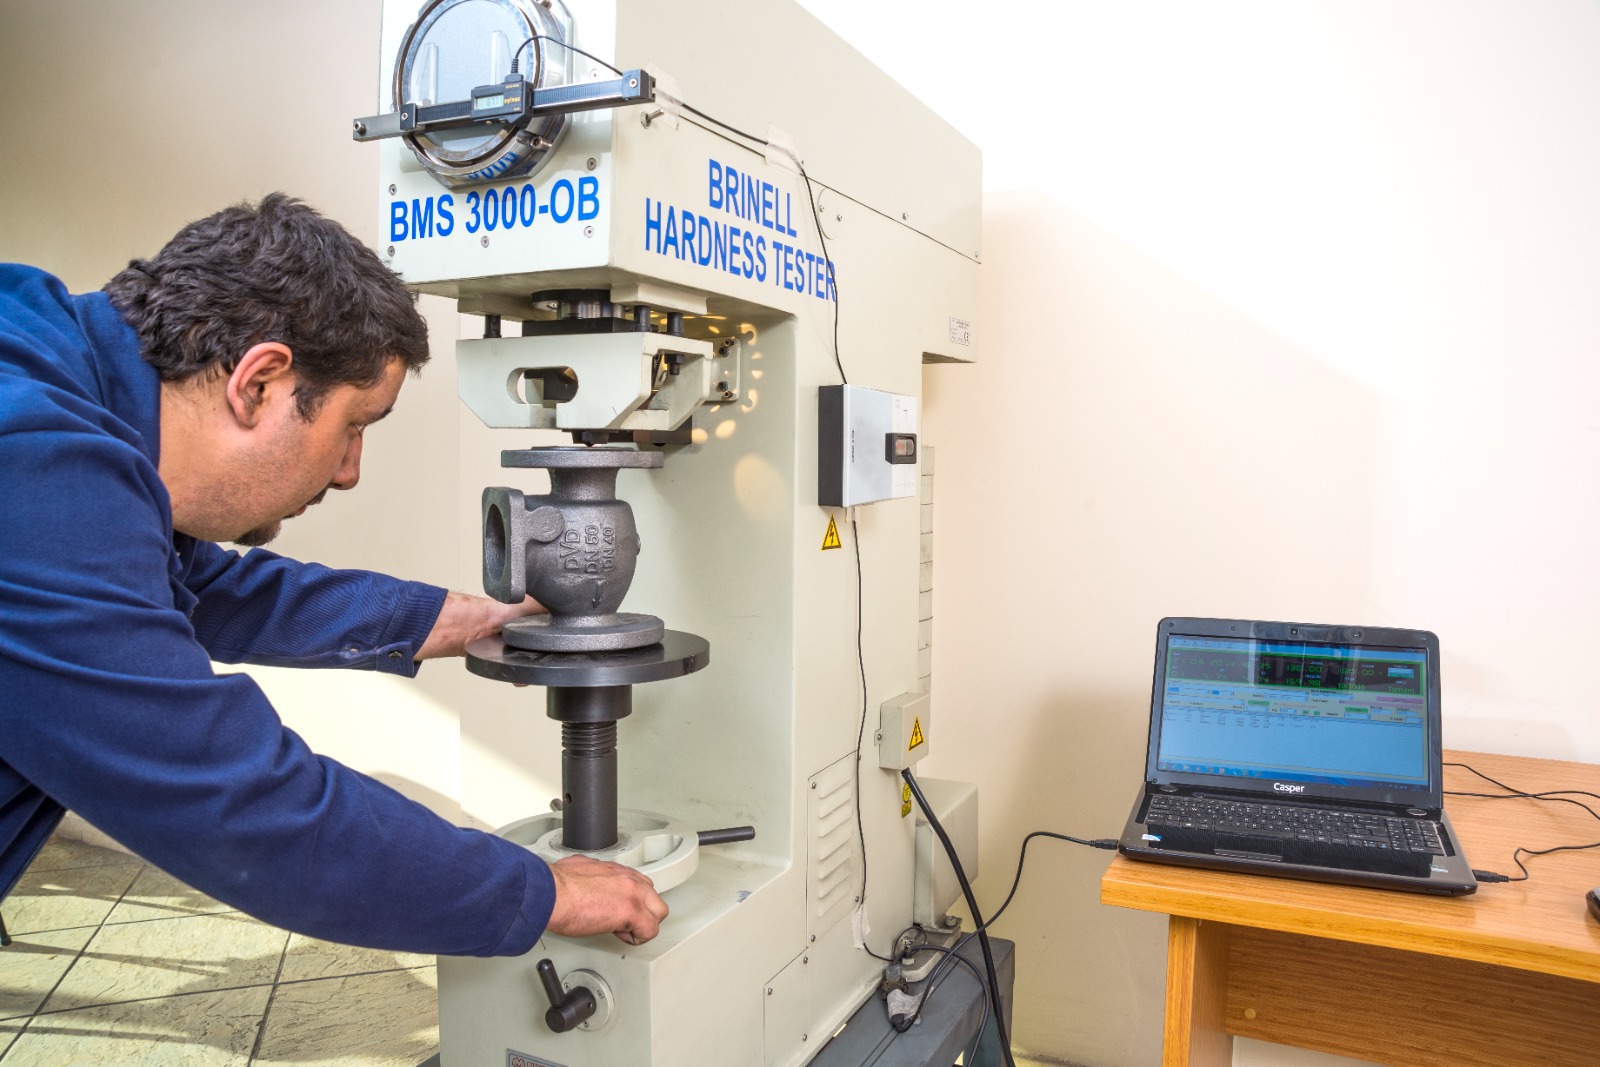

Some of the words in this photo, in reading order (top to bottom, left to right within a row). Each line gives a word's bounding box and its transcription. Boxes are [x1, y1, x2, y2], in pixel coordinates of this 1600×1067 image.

[390, 194, 455, 242] BMS
[465, 175, 600, 234] 3000-OB
[708, 158, 798, 238] BRINELL
[645, 197, 767, 283] HARDNESS
[772, 240, 837, 302] TESTER
[585, 524, 600, 545] 50
[603, 527, 615, 544] 40
[1273, 782, 1305, 794] Casper
